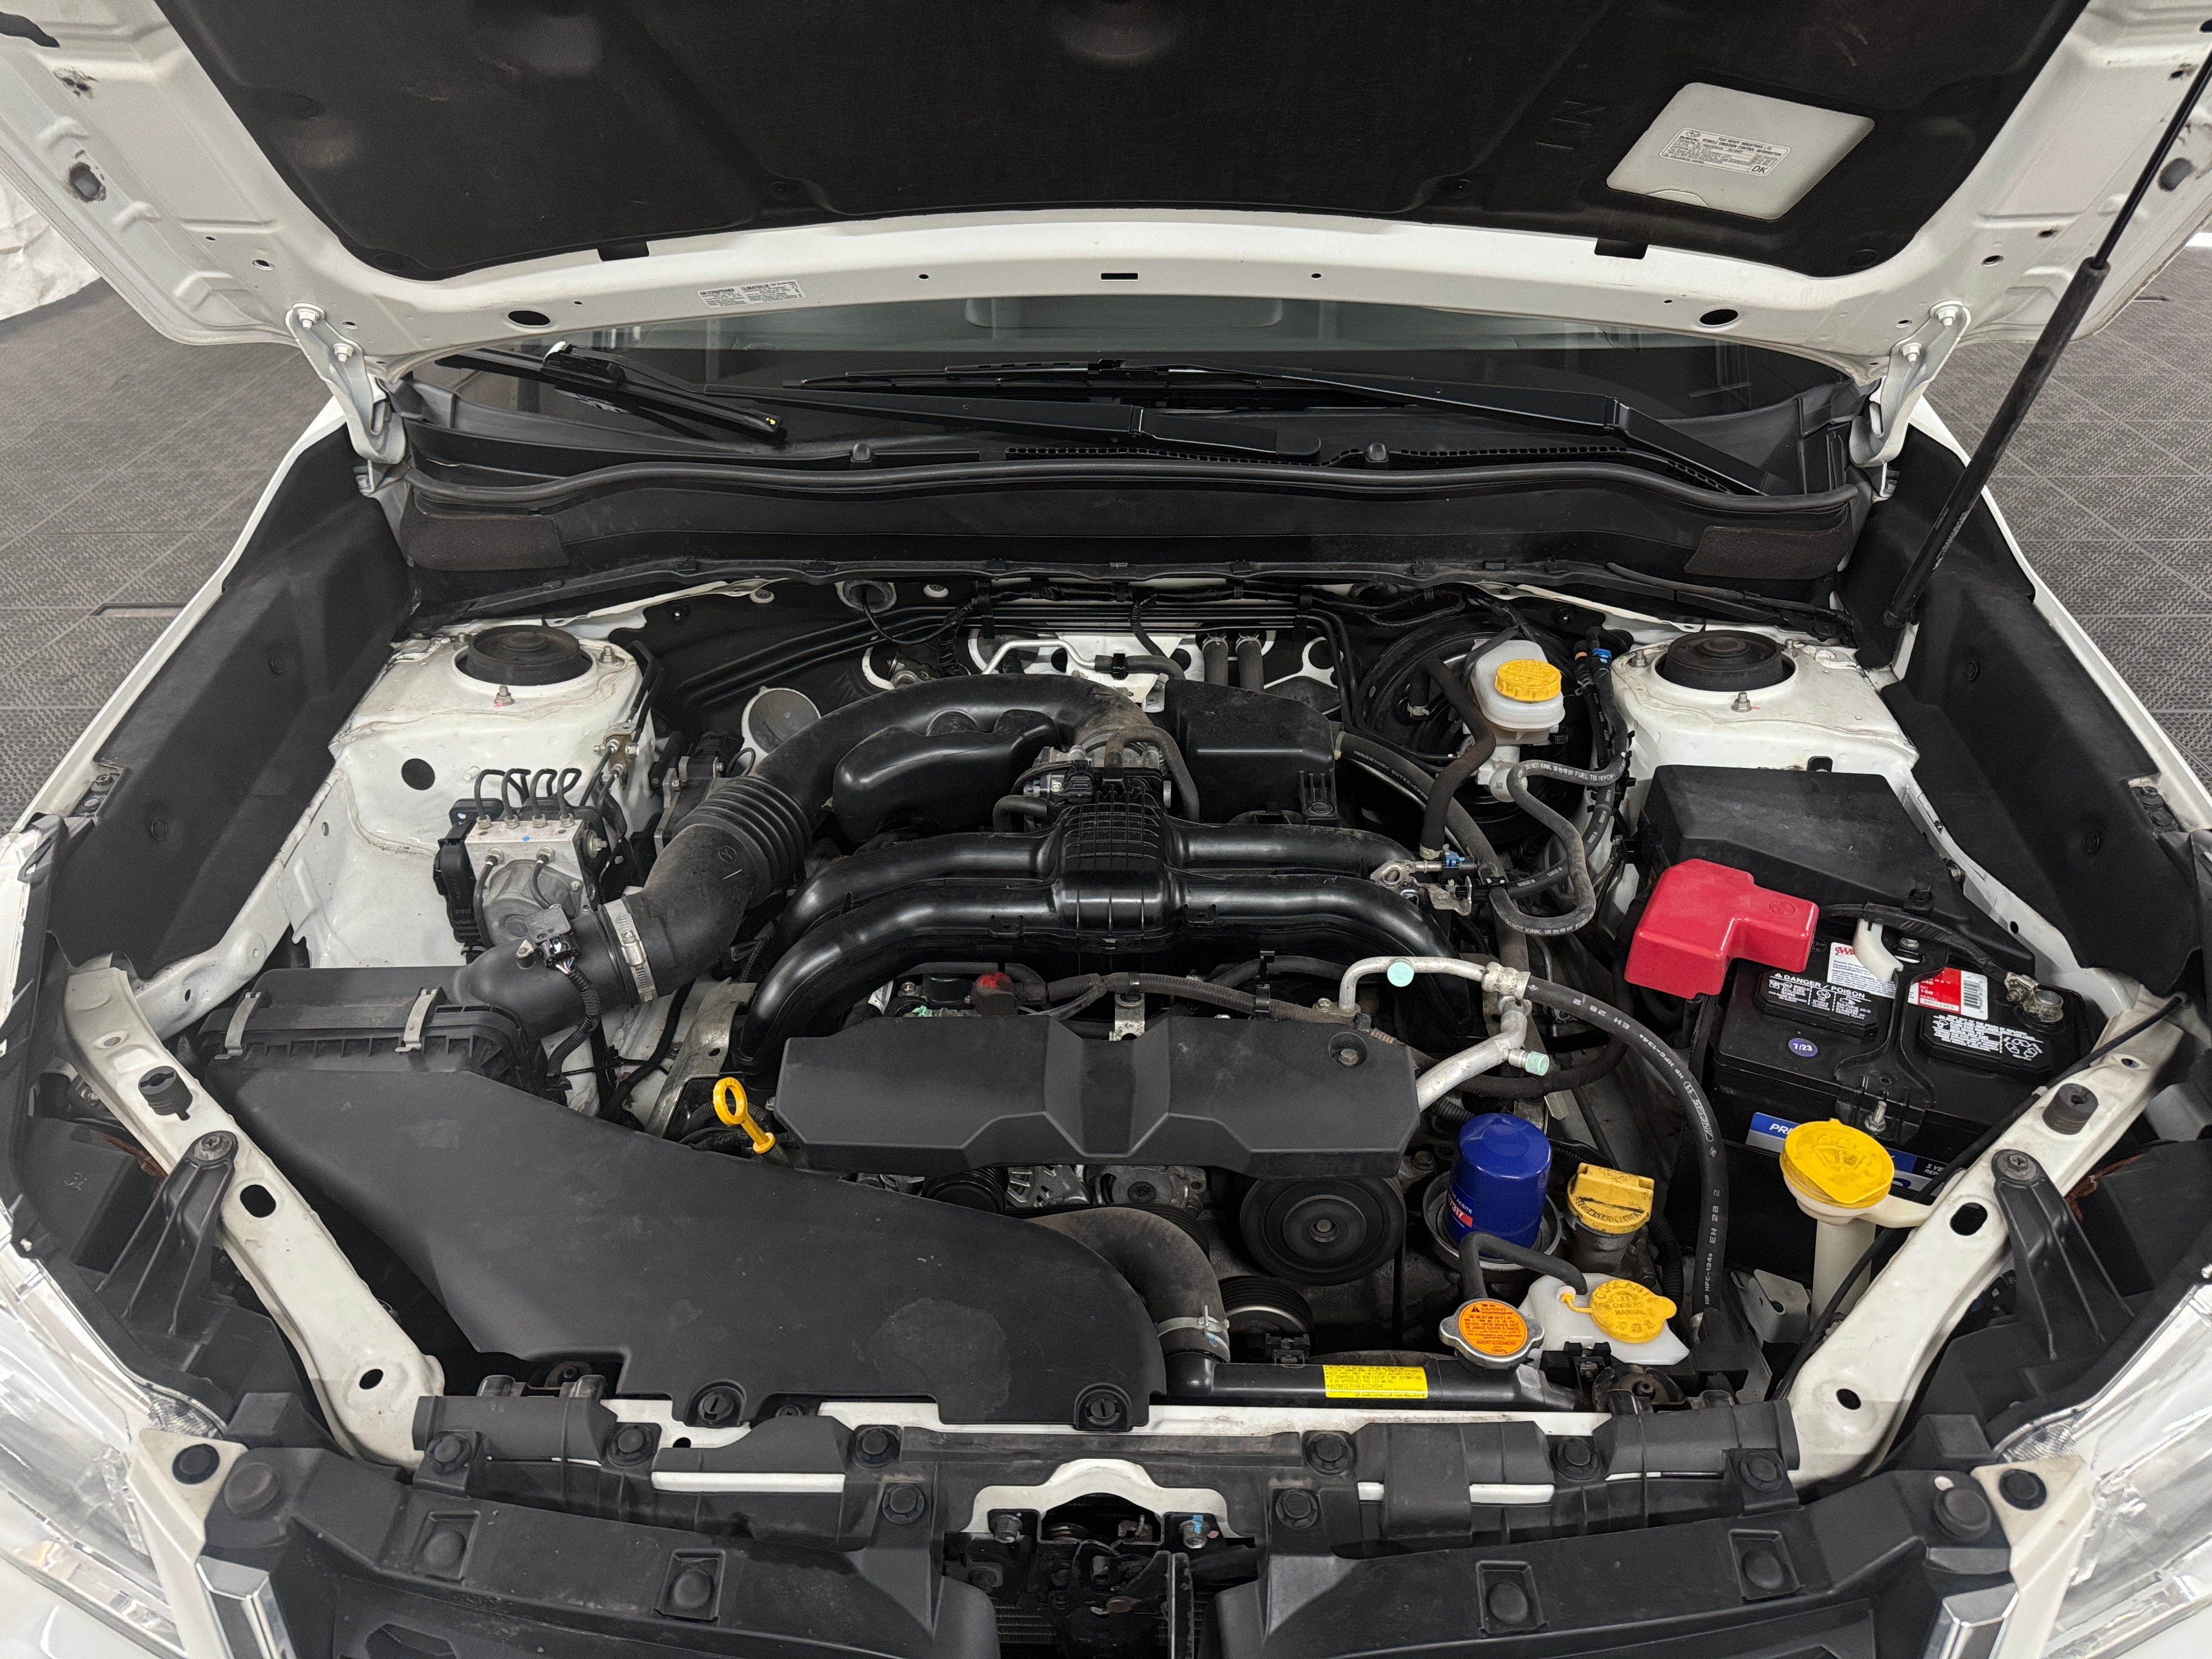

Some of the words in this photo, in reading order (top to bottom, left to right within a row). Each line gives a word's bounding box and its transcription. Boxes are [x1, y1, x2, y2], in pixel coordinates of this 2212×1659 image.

[1751, 166, 1769, 174] DK
[1575, 771, 1588, 780] FUEL
[1835, 947, 1855, 955] AAA
[1784, 974, 1821, 988] DANGER
[1831, 986, 1865, 998] POISON
[1613, 1017, 1630, 1030] EH
[1792, 1043, 1813, 1052] 7/23
[1674, 1068, 1684, 1079] HP
[1713, 1189, 1720, 1197] 2
[1456, 1198, 1472, 1214] ACEITE
[1709, 1228, 1718, 1244] EH
[1705, 1253, 1713, 1292] HFC-134a
[1595, 1282, 1654, 1299] COOLANT
[1705, 1295, 1710, 1305] HP
